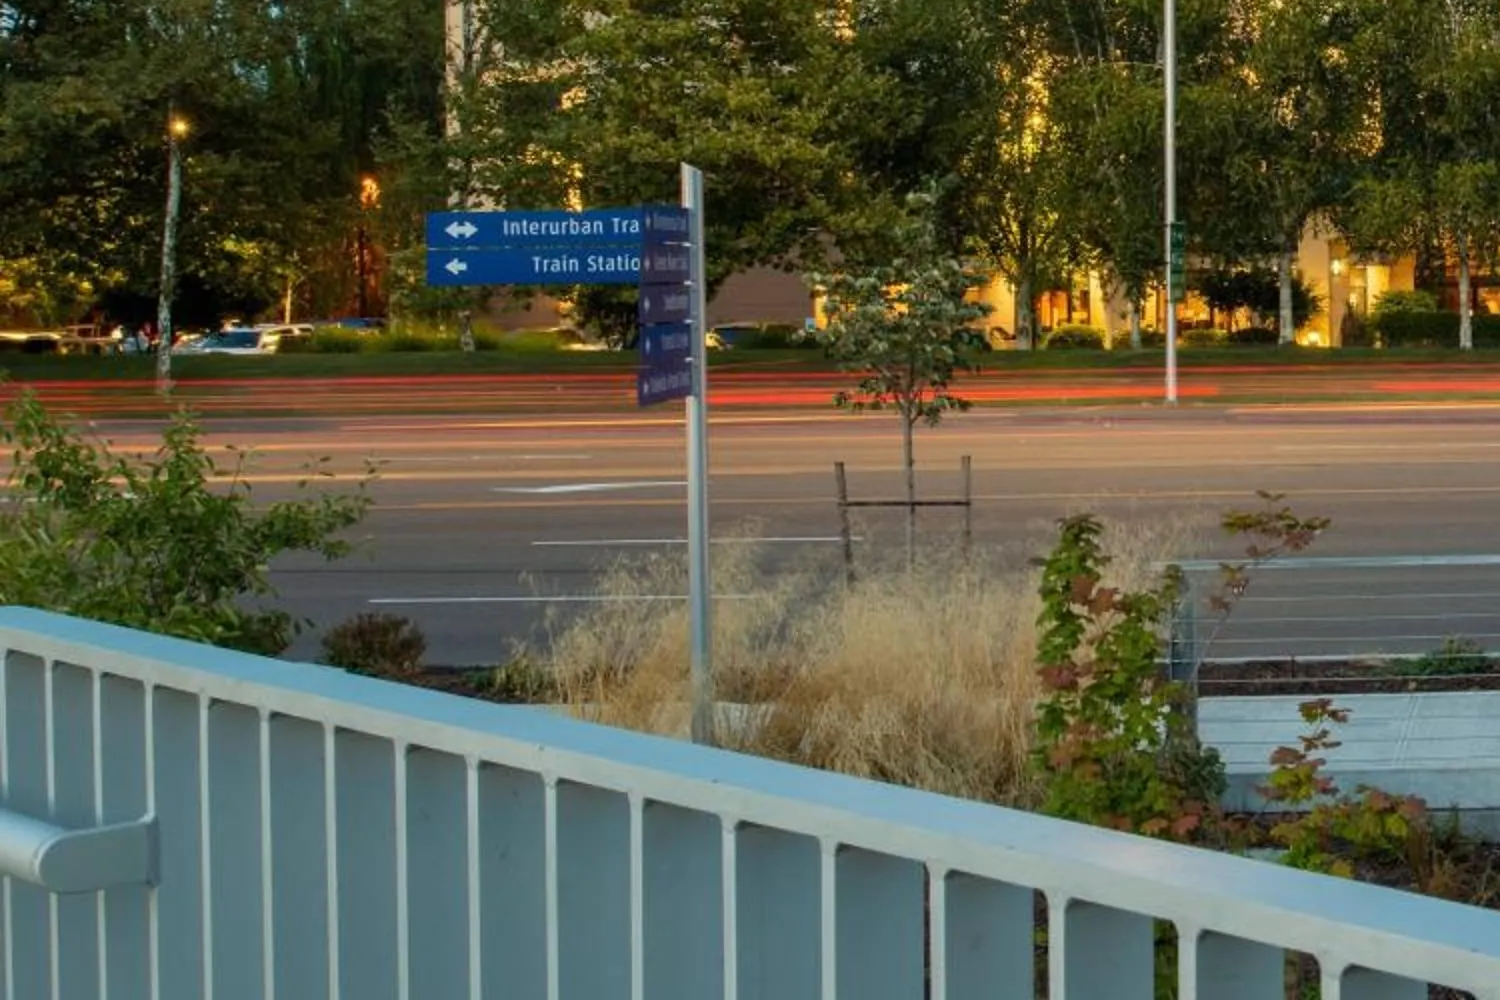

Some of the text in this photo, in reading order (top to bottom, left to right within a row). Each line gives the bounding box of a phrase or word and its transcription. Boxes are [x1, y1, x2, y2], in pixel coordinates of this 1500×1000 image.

[503, 218, 603, 235] Interurban
[612, 217, 640, 233] Tra
[532, 256, 579, 273] Train
[587, 254, 641, 272] Statio
